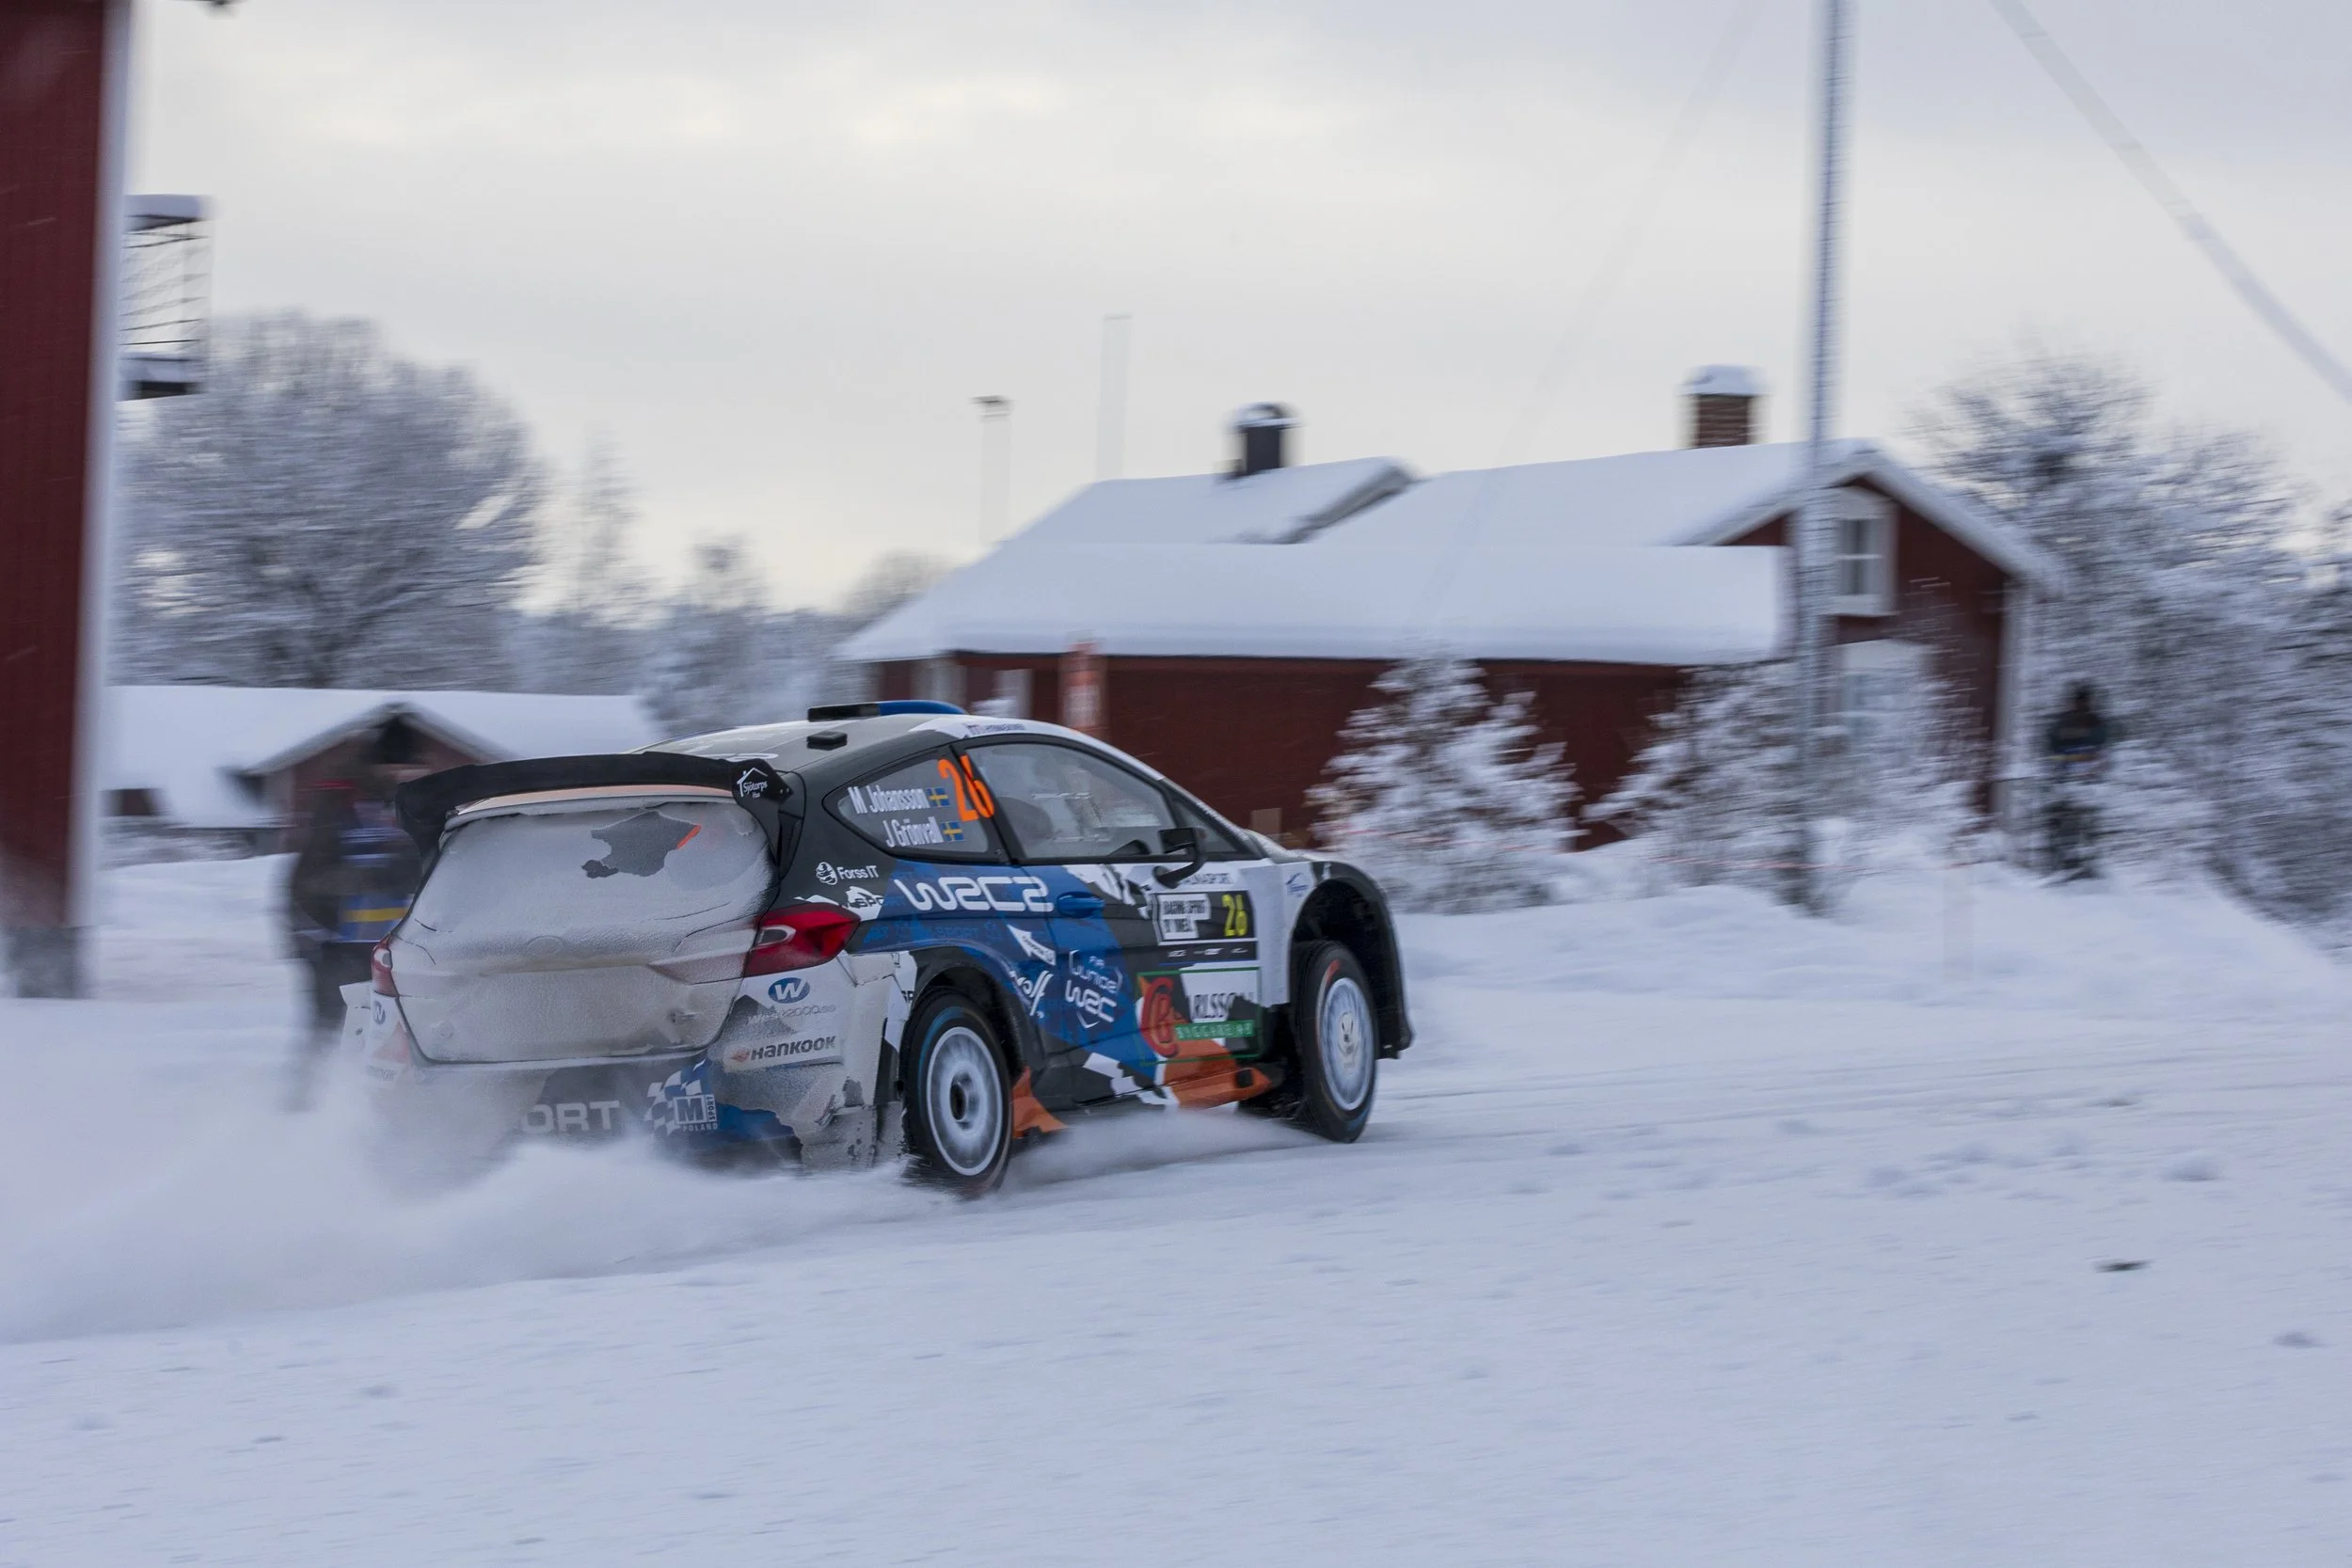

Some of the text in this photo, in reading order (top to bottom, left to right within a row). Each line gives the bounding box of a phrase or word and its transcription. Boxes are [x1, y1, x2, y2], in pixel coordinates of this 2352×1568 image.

[848, 784, 930, 815] M Johansson
[937, 754, 994, 822] 26
[882, 816, 945, 847] J Grönvall
[836, 865, 879, 879] Forss IT
[894, 876, 1055, 911] WRC2
[1221, 894, 1248, 936] 26
[775, 978, 809, 1000] W
[1065, 979, 1117, 1022] WRC
[676, 1098, 704, 1122] M
[683, 1124, 718, 1132] POLAND
